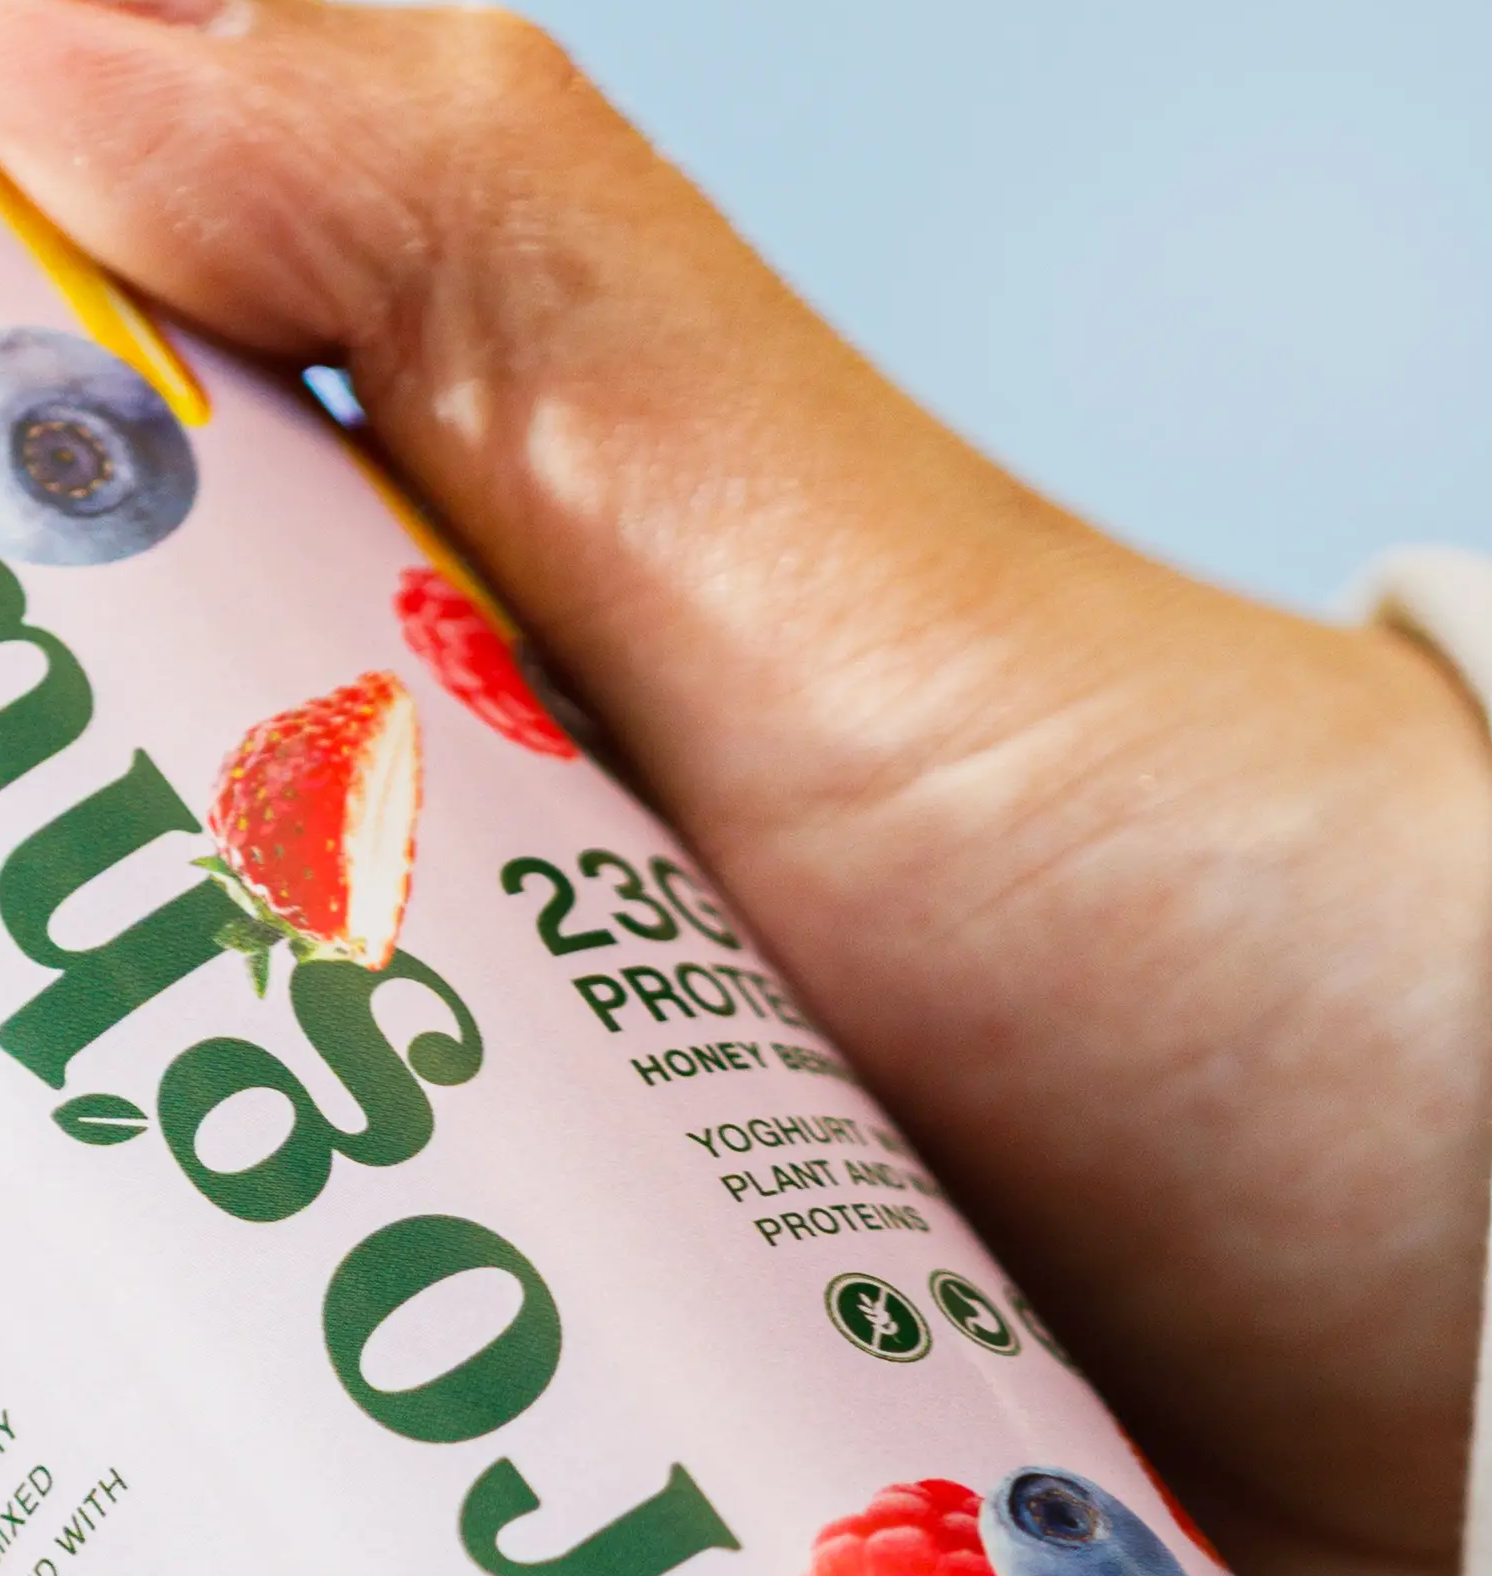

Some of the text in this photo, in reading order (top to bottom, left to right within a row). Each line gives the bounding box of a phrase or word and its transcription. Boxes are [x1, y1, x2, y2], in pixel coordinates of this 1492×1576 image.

[631, 1041, 768, 1087] HONEY
[685, 1116, 868, 1159] YOGHURT
[720, 1159, 840, 1204] PLANT
[842, 1158, 907, 1191] AND
[753, 1203, 931, 1247] PROTEINS
[54, 1467, 129, 1556] WITH
